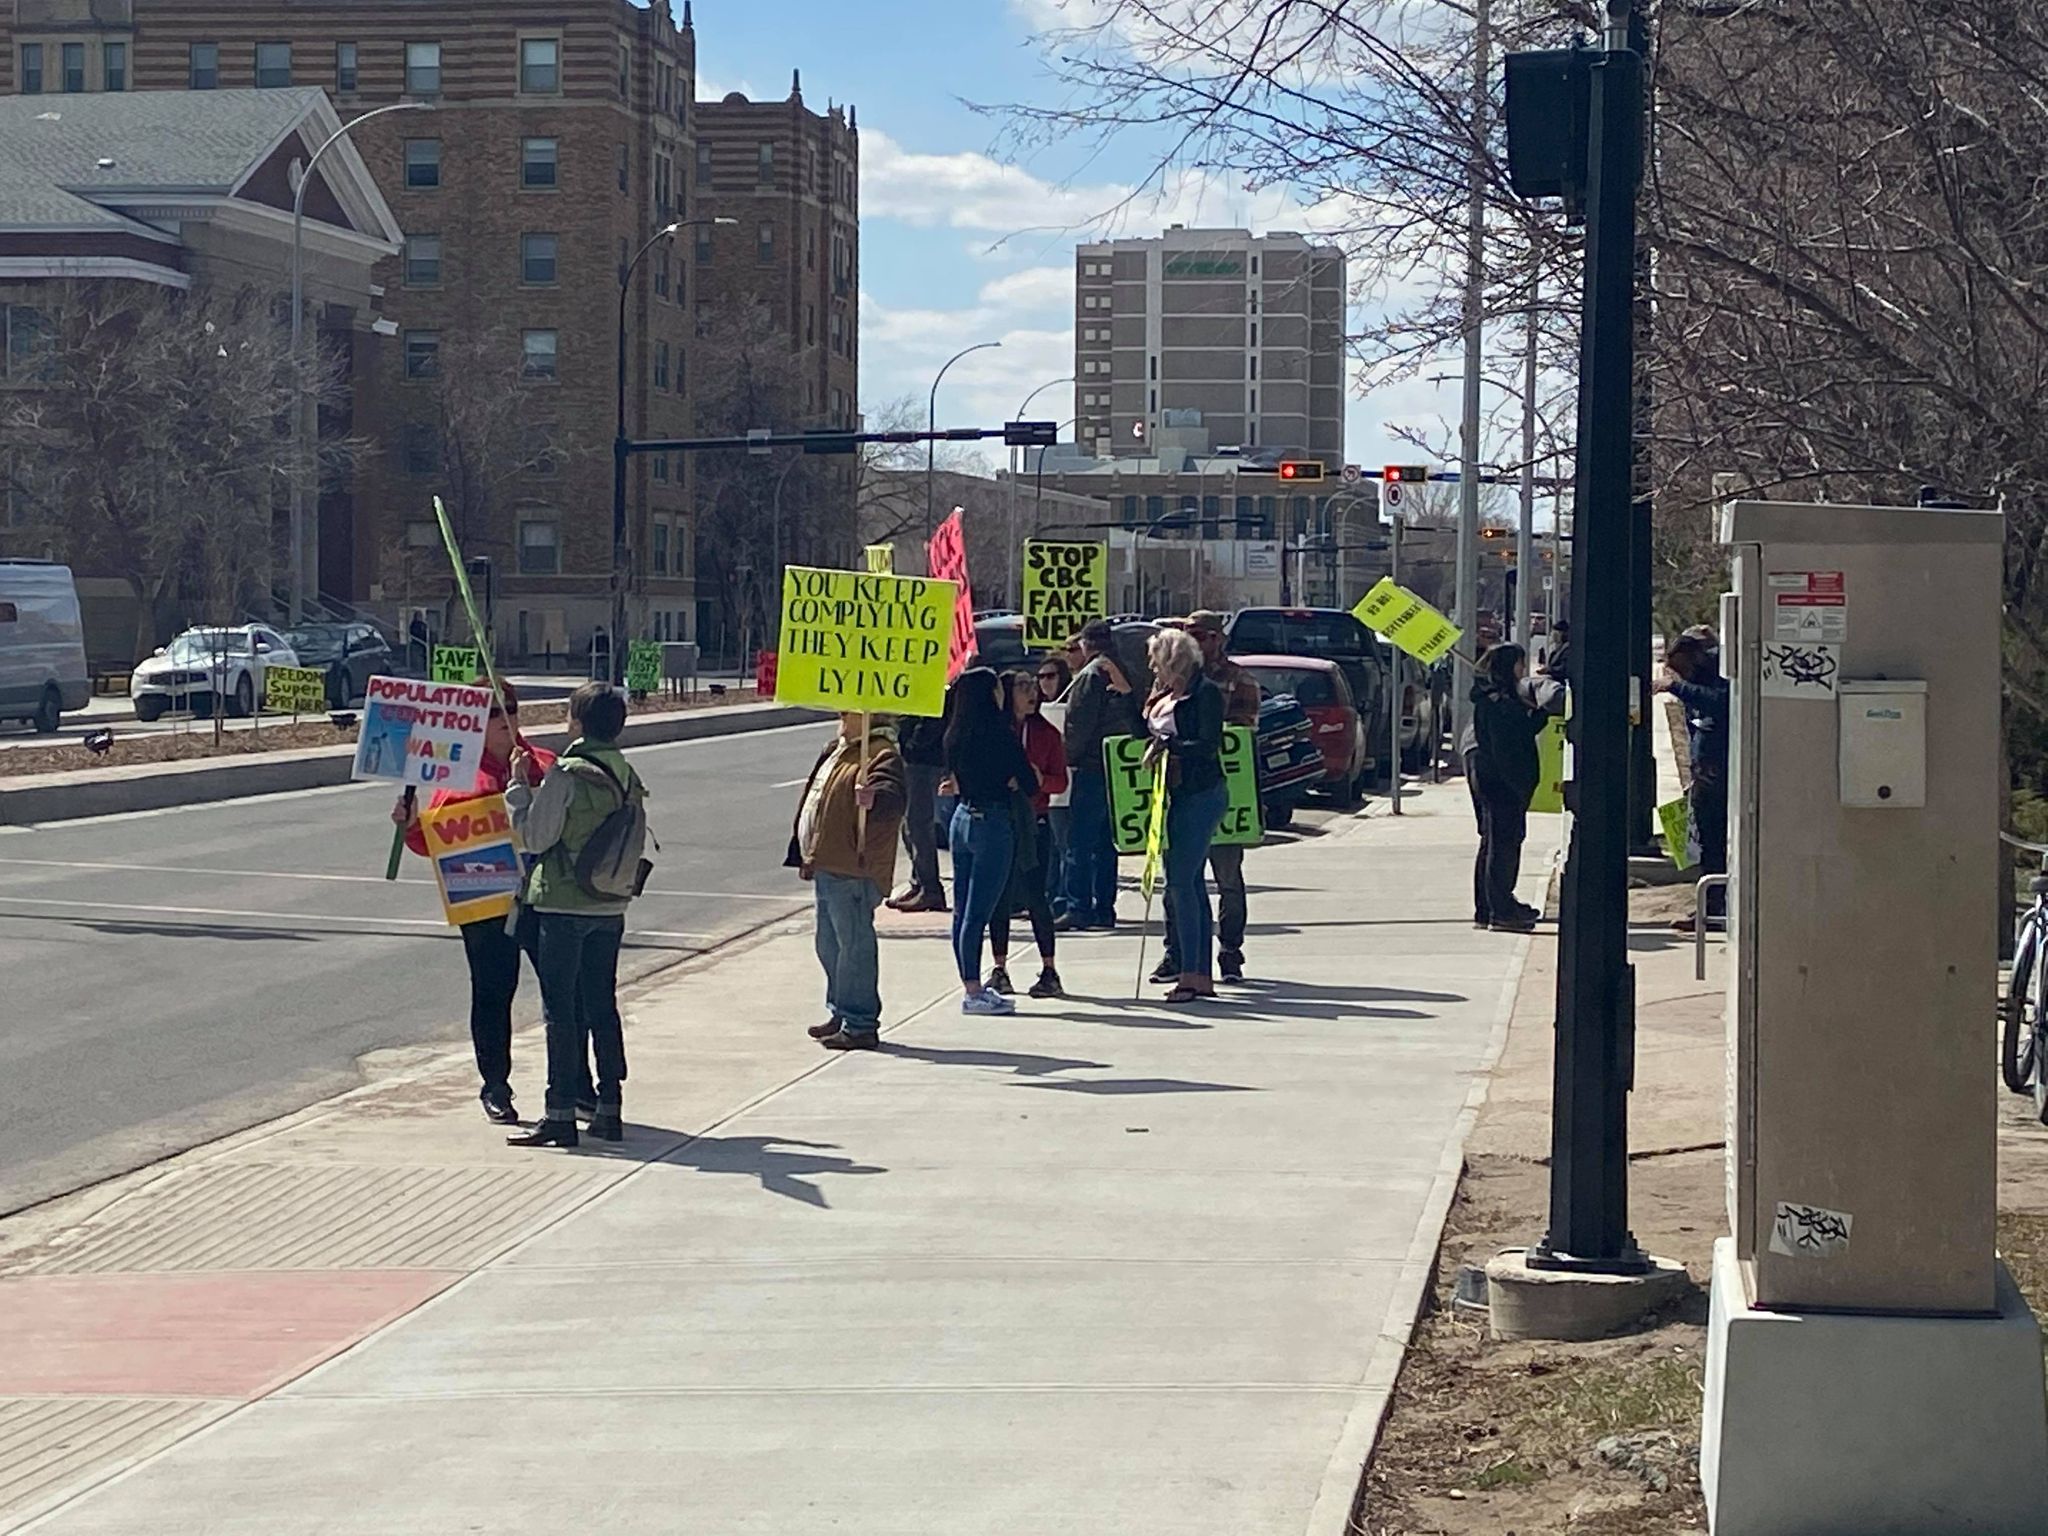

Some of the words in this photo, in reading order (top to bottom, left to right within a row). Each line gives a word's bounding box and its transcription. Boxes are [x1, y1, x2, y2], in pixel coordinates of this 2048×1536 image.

[1028, 545, 1099, 569] STOP
[790, 571, 839, 598] YOU
[853, 576, 926, 605] KEEP
[1040, 567, 1093, 588] CBC
[1029, 590, 1099, 614] FAKE
[788, 599, 937, 630] COMPLYING
[1026, 615, 1102, 640] NEW
[434, 649, 476, 667] SAVE
[788, 628, 852, 658] THEY
[861, 635, 939, 664] KEEP
[265, 666, 325, 684] FREEDOM
[440, 667, 465, 682] THE
[819, 667, 910, 698] LYING
[270, 680, 321, 697] Super
[369, 679, 489, 708] POPULATION
[380, 705, 483, 733] CONTROL
[405, 738, 463, 762] WAKE
[421, 763, 450, 782] UP
[432, 810, 511, 845] Wak
